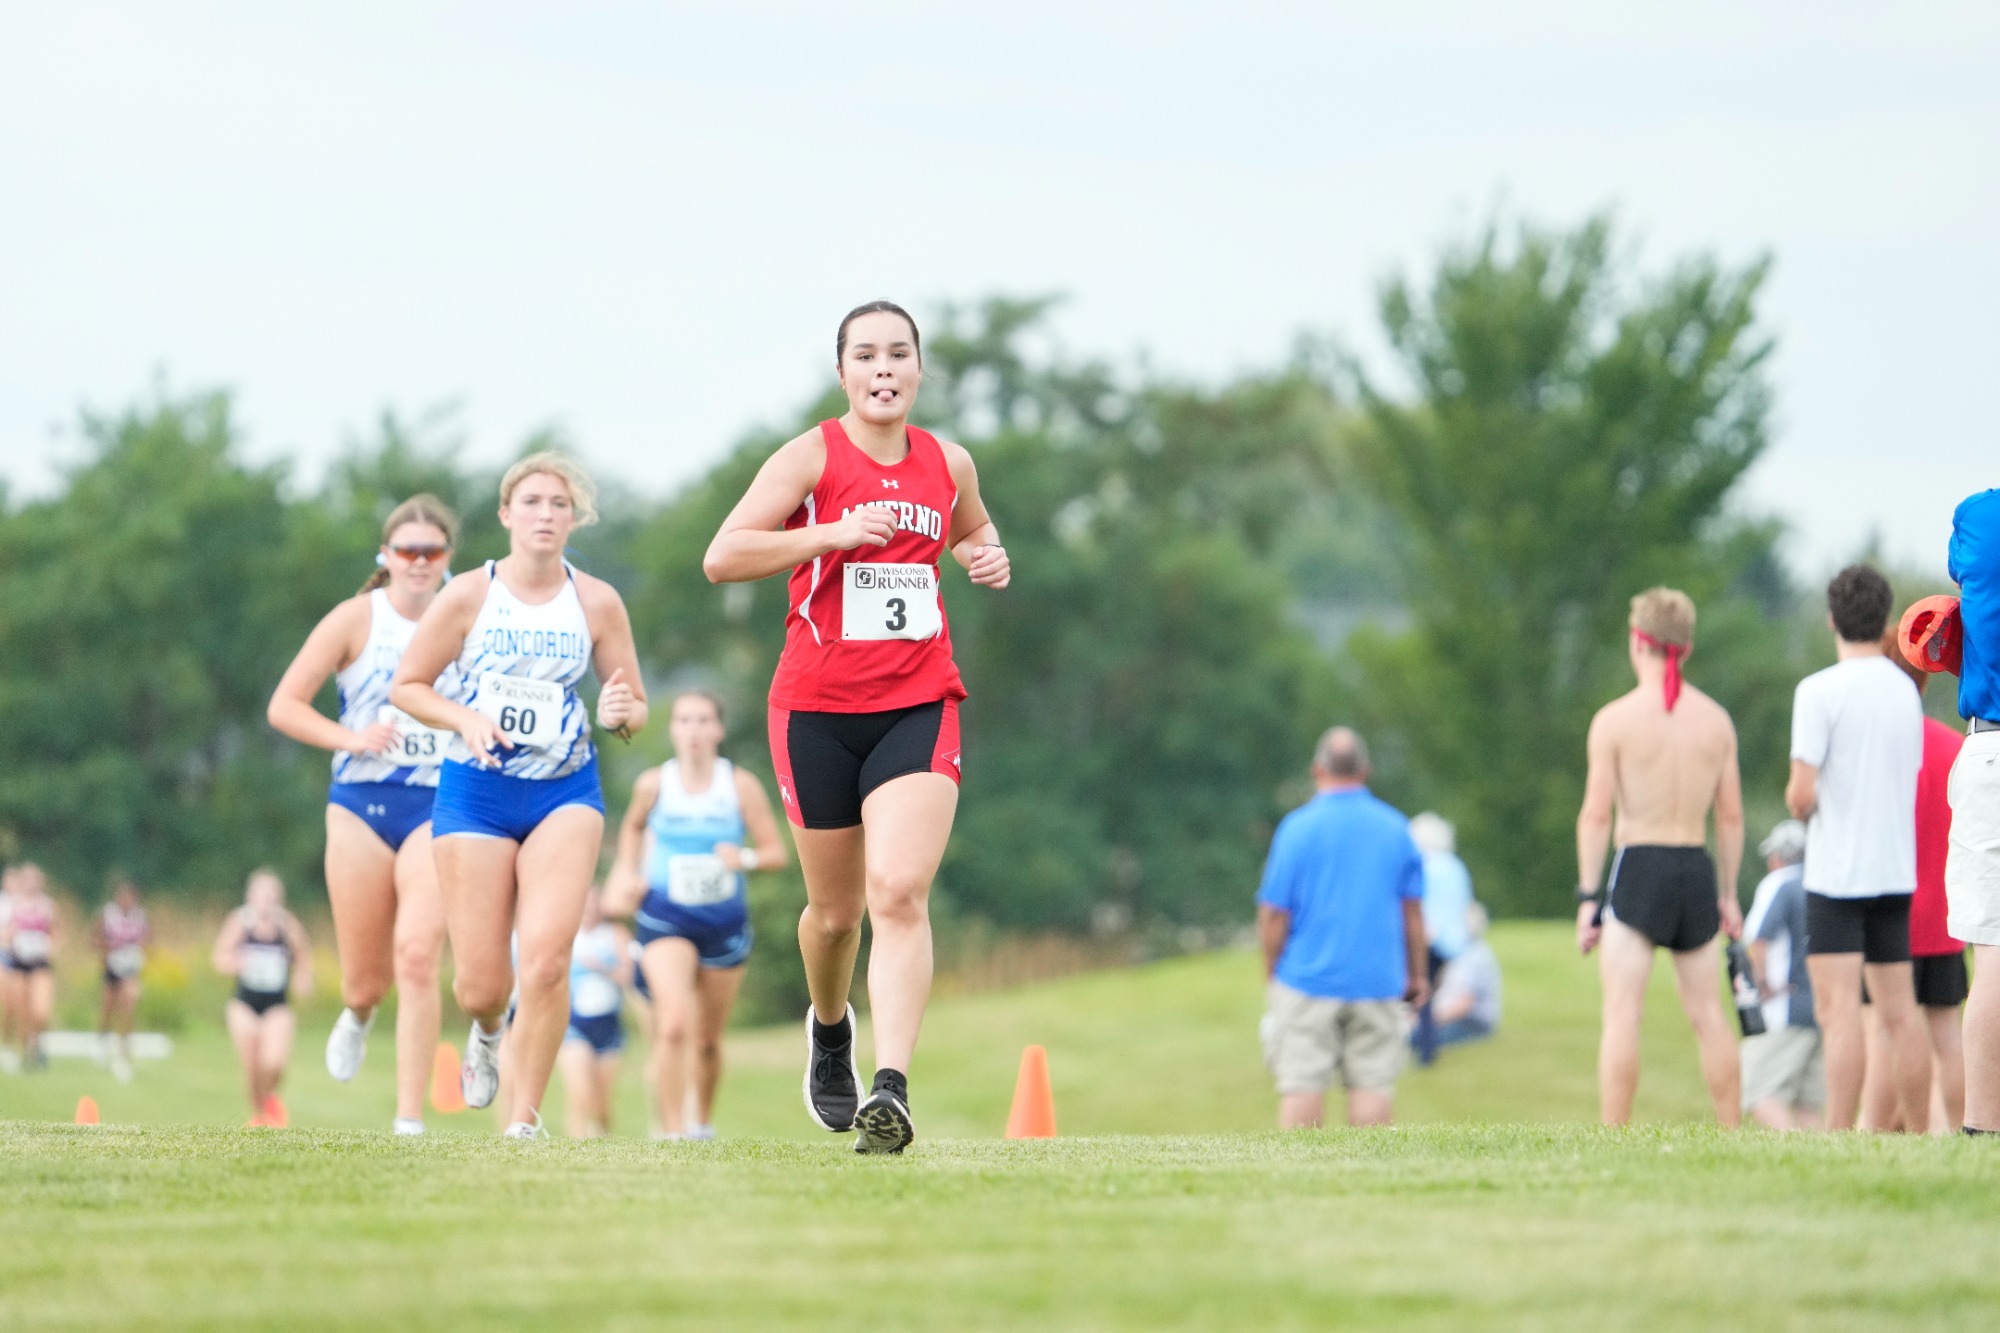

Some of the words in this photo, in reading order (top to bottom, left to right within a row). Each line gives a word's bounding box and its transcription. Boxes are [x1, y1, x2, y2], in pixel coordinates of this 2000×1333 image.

[878, 577, 929, 589] RUNNER
[882, 566, 928, 576] WISCONSIN
[885, 597, 907, 631] 3
[500, 705, 536, 735] 60
[403, 732, 437, 756] 63
